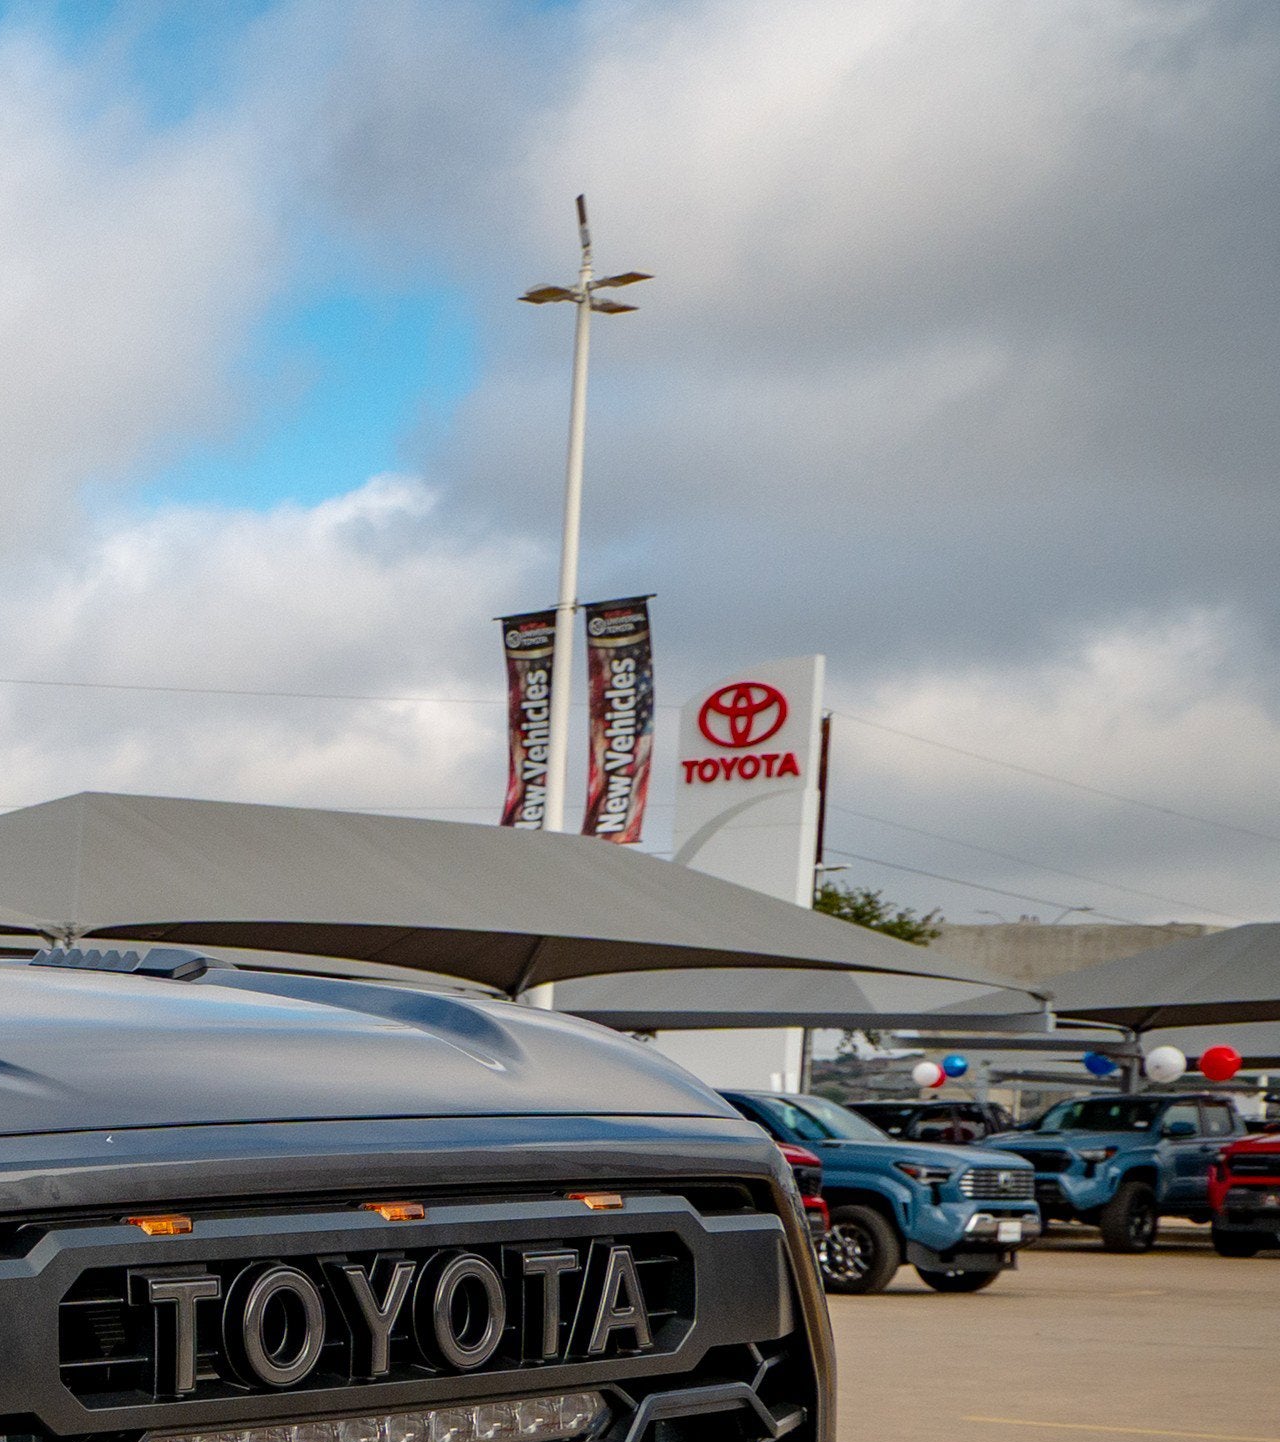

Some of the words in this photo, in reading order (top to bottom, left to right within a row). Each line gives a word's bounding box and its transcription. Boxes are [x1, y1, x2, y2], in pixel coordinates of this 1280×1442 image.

[521, 669, 549, 780] Vehicles
[604, 657, 636, 771] Vehicles
[682, 753, 800, 784] TOYOTA
[595, 775, 632, 833] New
[140, 1240, 654, 1396] TOYOTA
